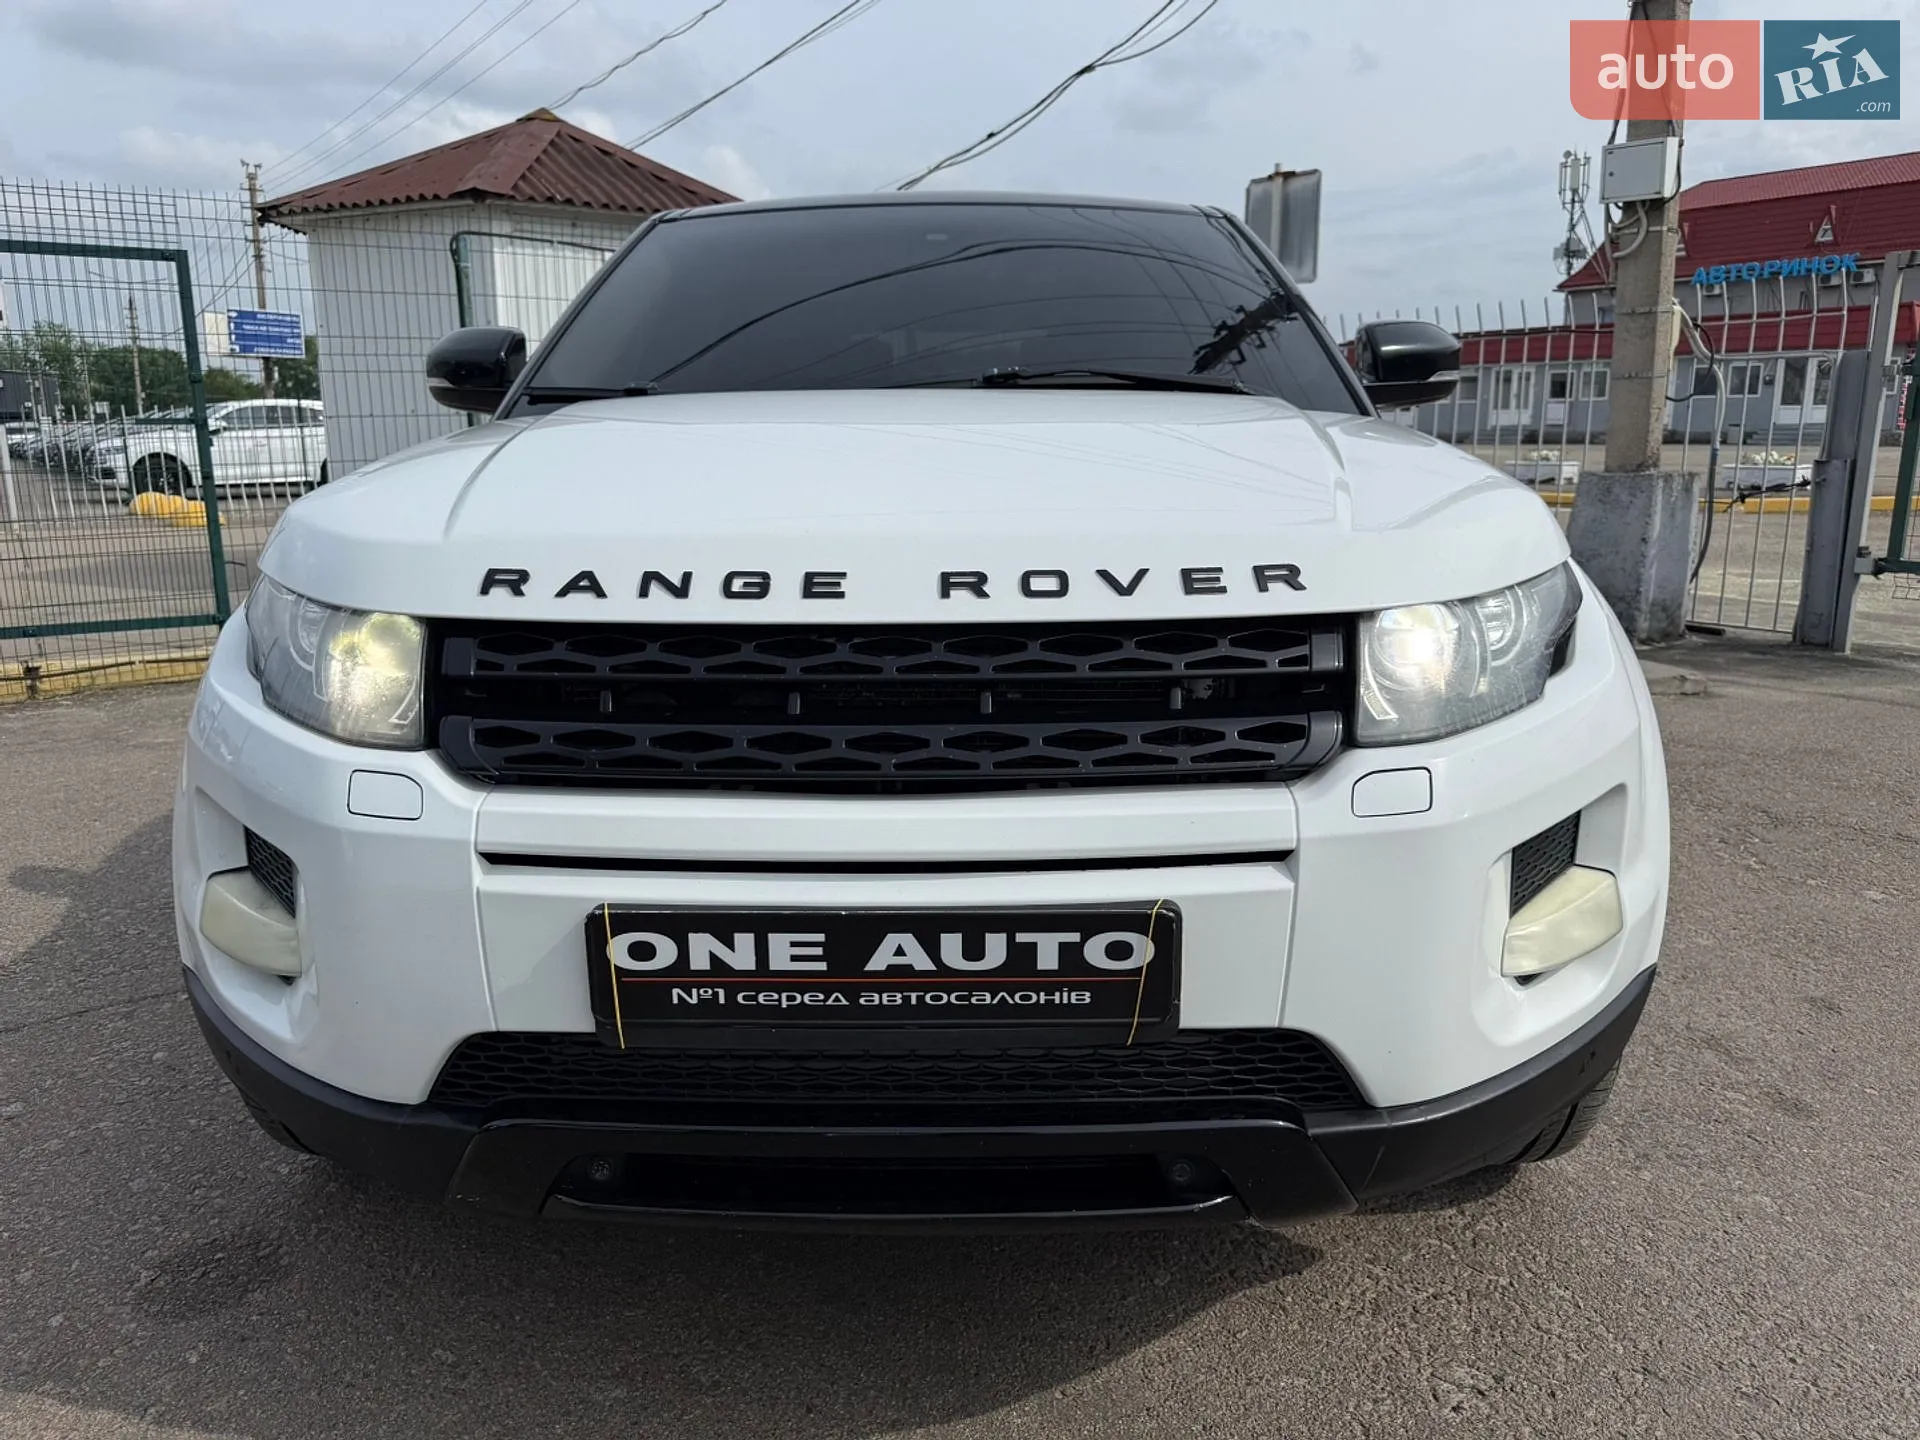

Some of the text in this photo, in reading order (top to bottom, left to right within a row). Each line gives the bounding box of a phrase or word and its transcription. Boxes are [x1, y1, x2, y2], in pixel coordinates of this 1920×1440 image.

[1691, 253, 1860, 286] АВТОРИНОК
[479, 564, 1308, 600] RANGE ROVER
[606, 931, 1156, 971] ONE AUTO
[671, 987, 1092, 1008] №1 серед автосалонів
